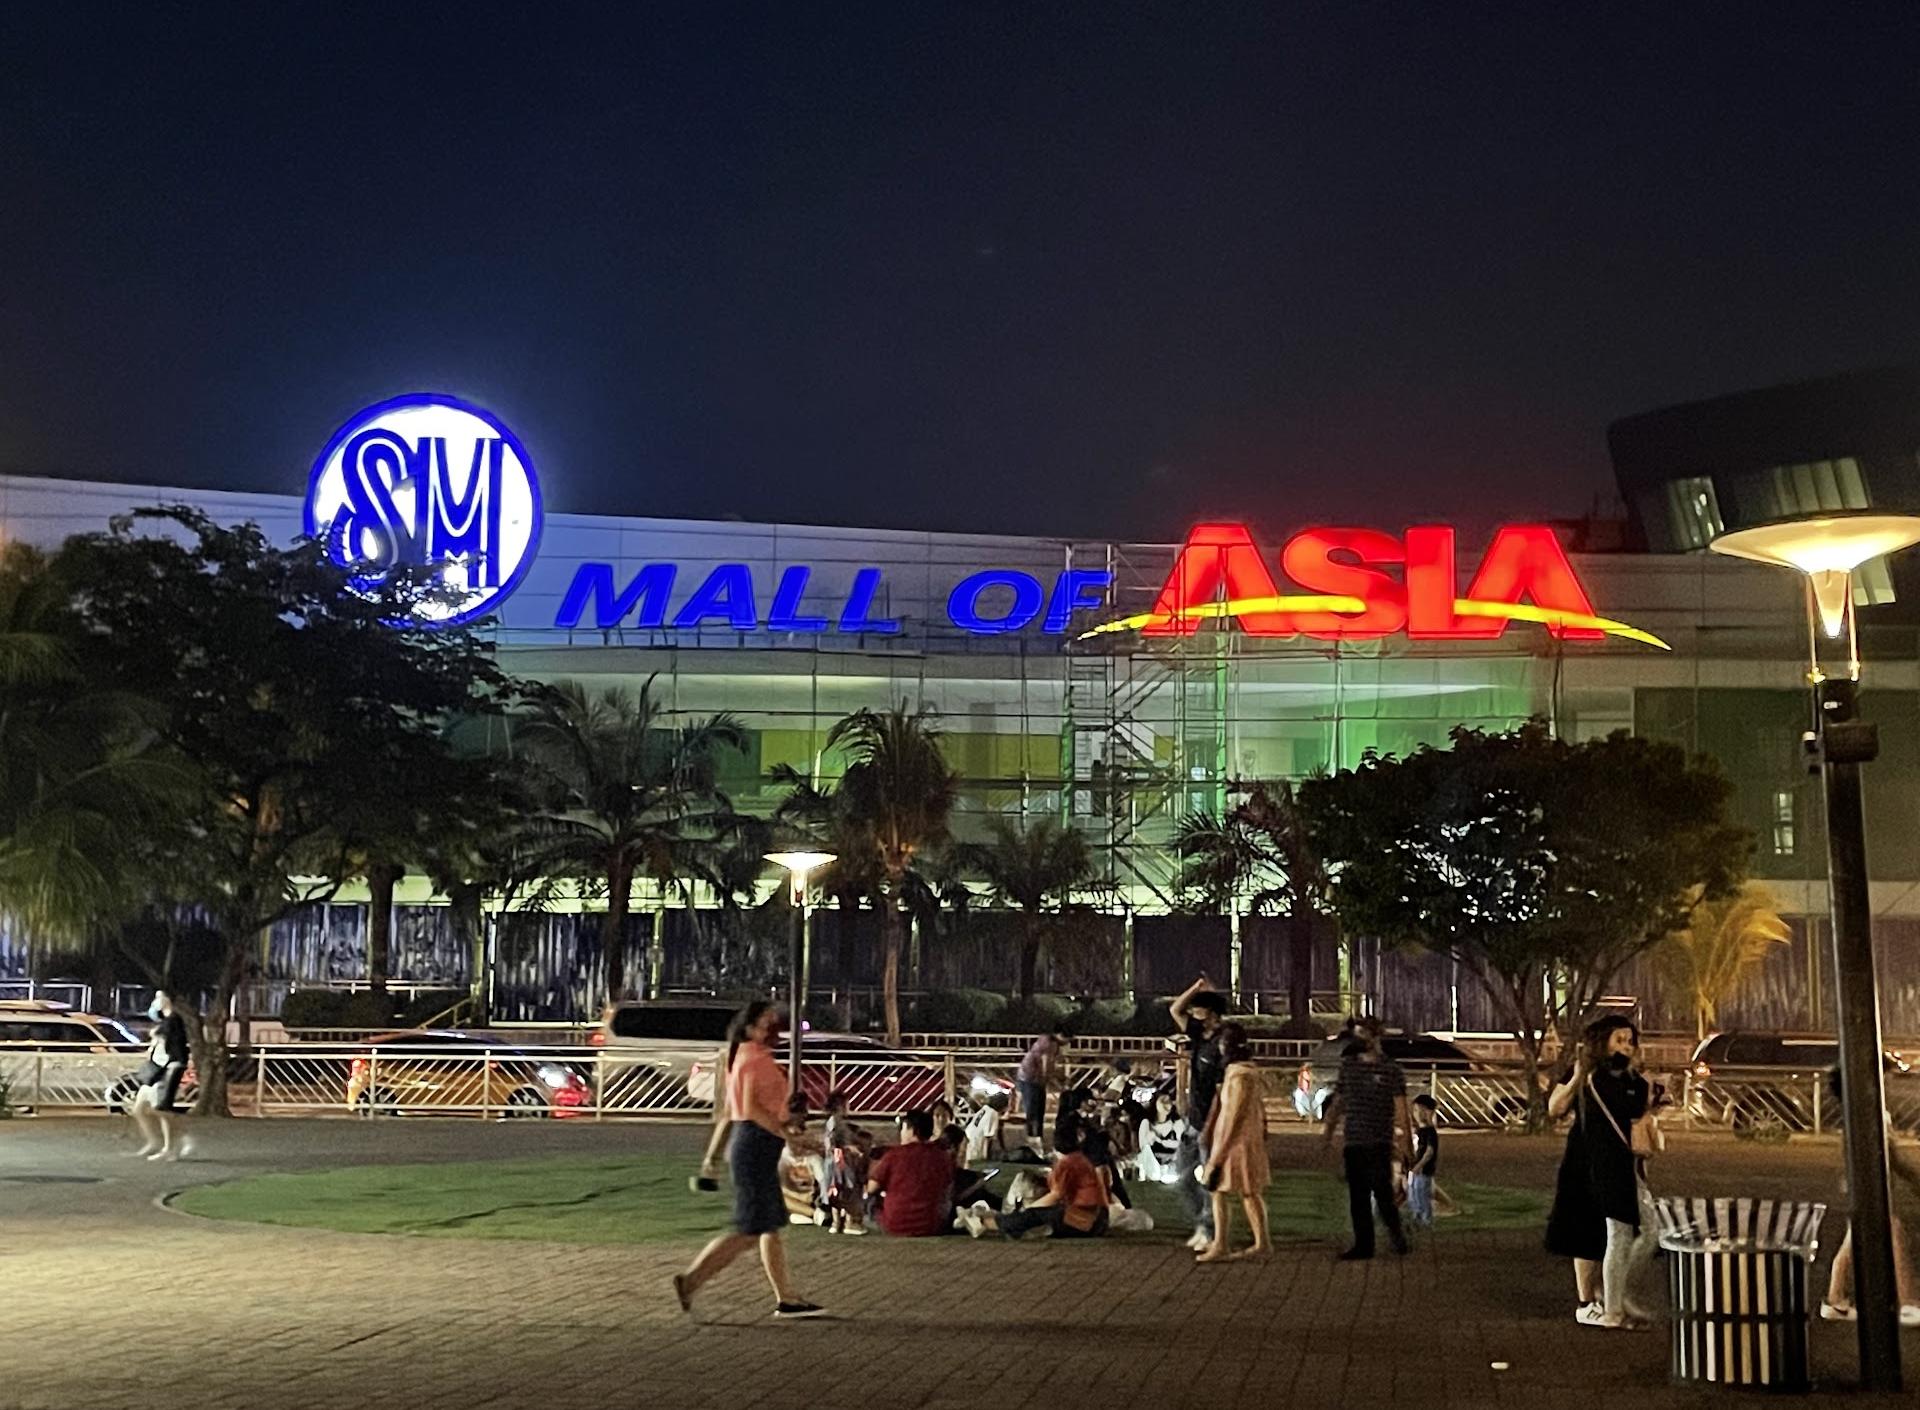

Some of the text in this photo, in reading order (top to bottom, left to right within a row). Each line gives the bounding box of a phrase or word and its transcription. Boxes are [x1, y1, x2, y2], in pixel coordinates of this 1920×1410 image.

[328, 428, 501, 591] SM
[555, 522, 1606, 640] MALL OF ASIA
